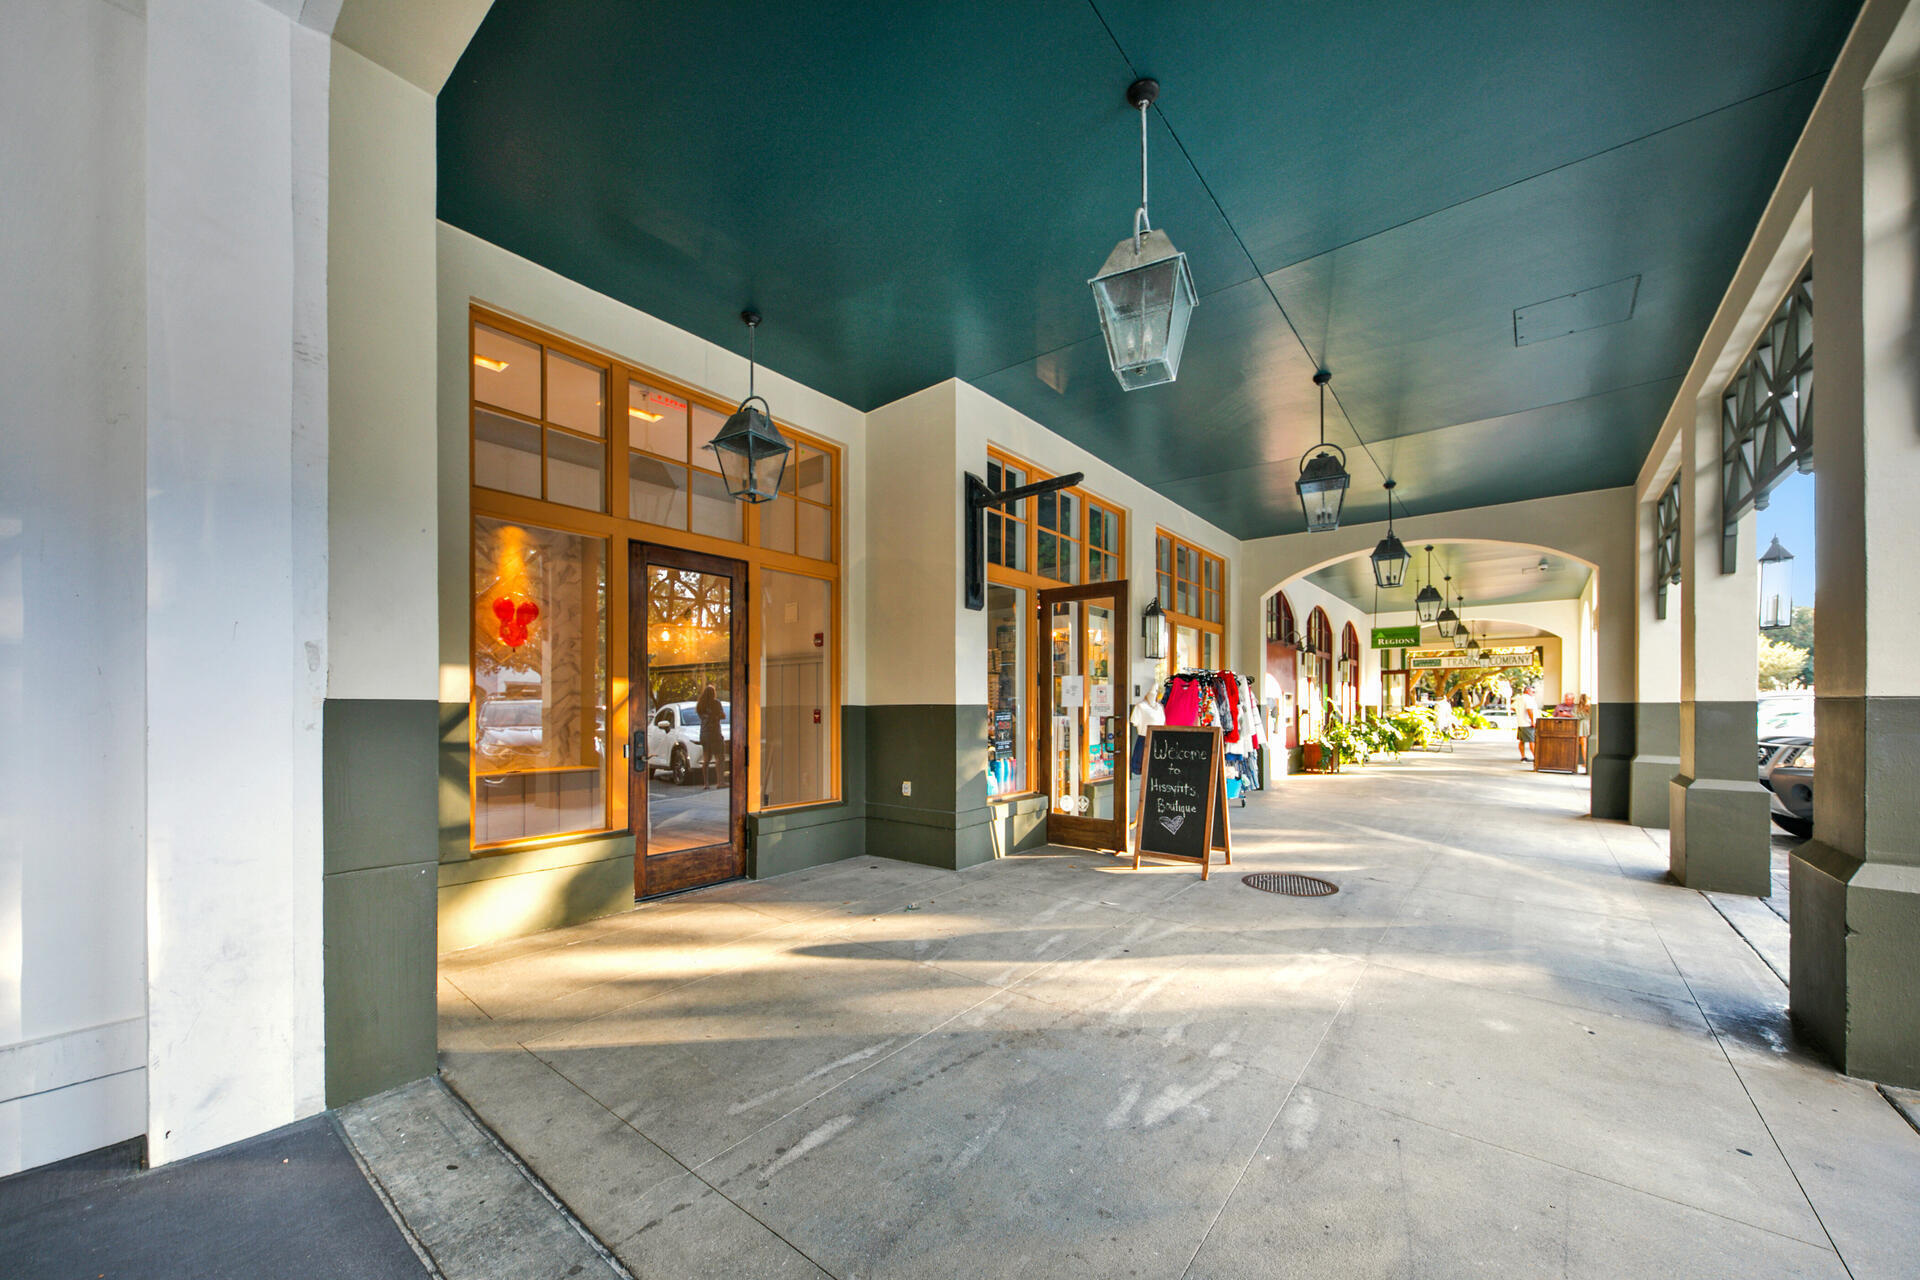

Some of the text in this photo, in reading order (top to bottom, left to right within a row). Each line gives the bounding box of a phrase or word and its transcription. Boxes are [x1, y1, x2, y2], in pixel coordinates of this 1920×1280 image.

[1377, 637, 1416, 646] REGIONS
[1447, 657, 1481, 666] TRADIN
[1489, 655, 1531, 665] COMPANY
[1153, 739, 1207, 760] Welcome
[1168, 762, 1181, 775] to
